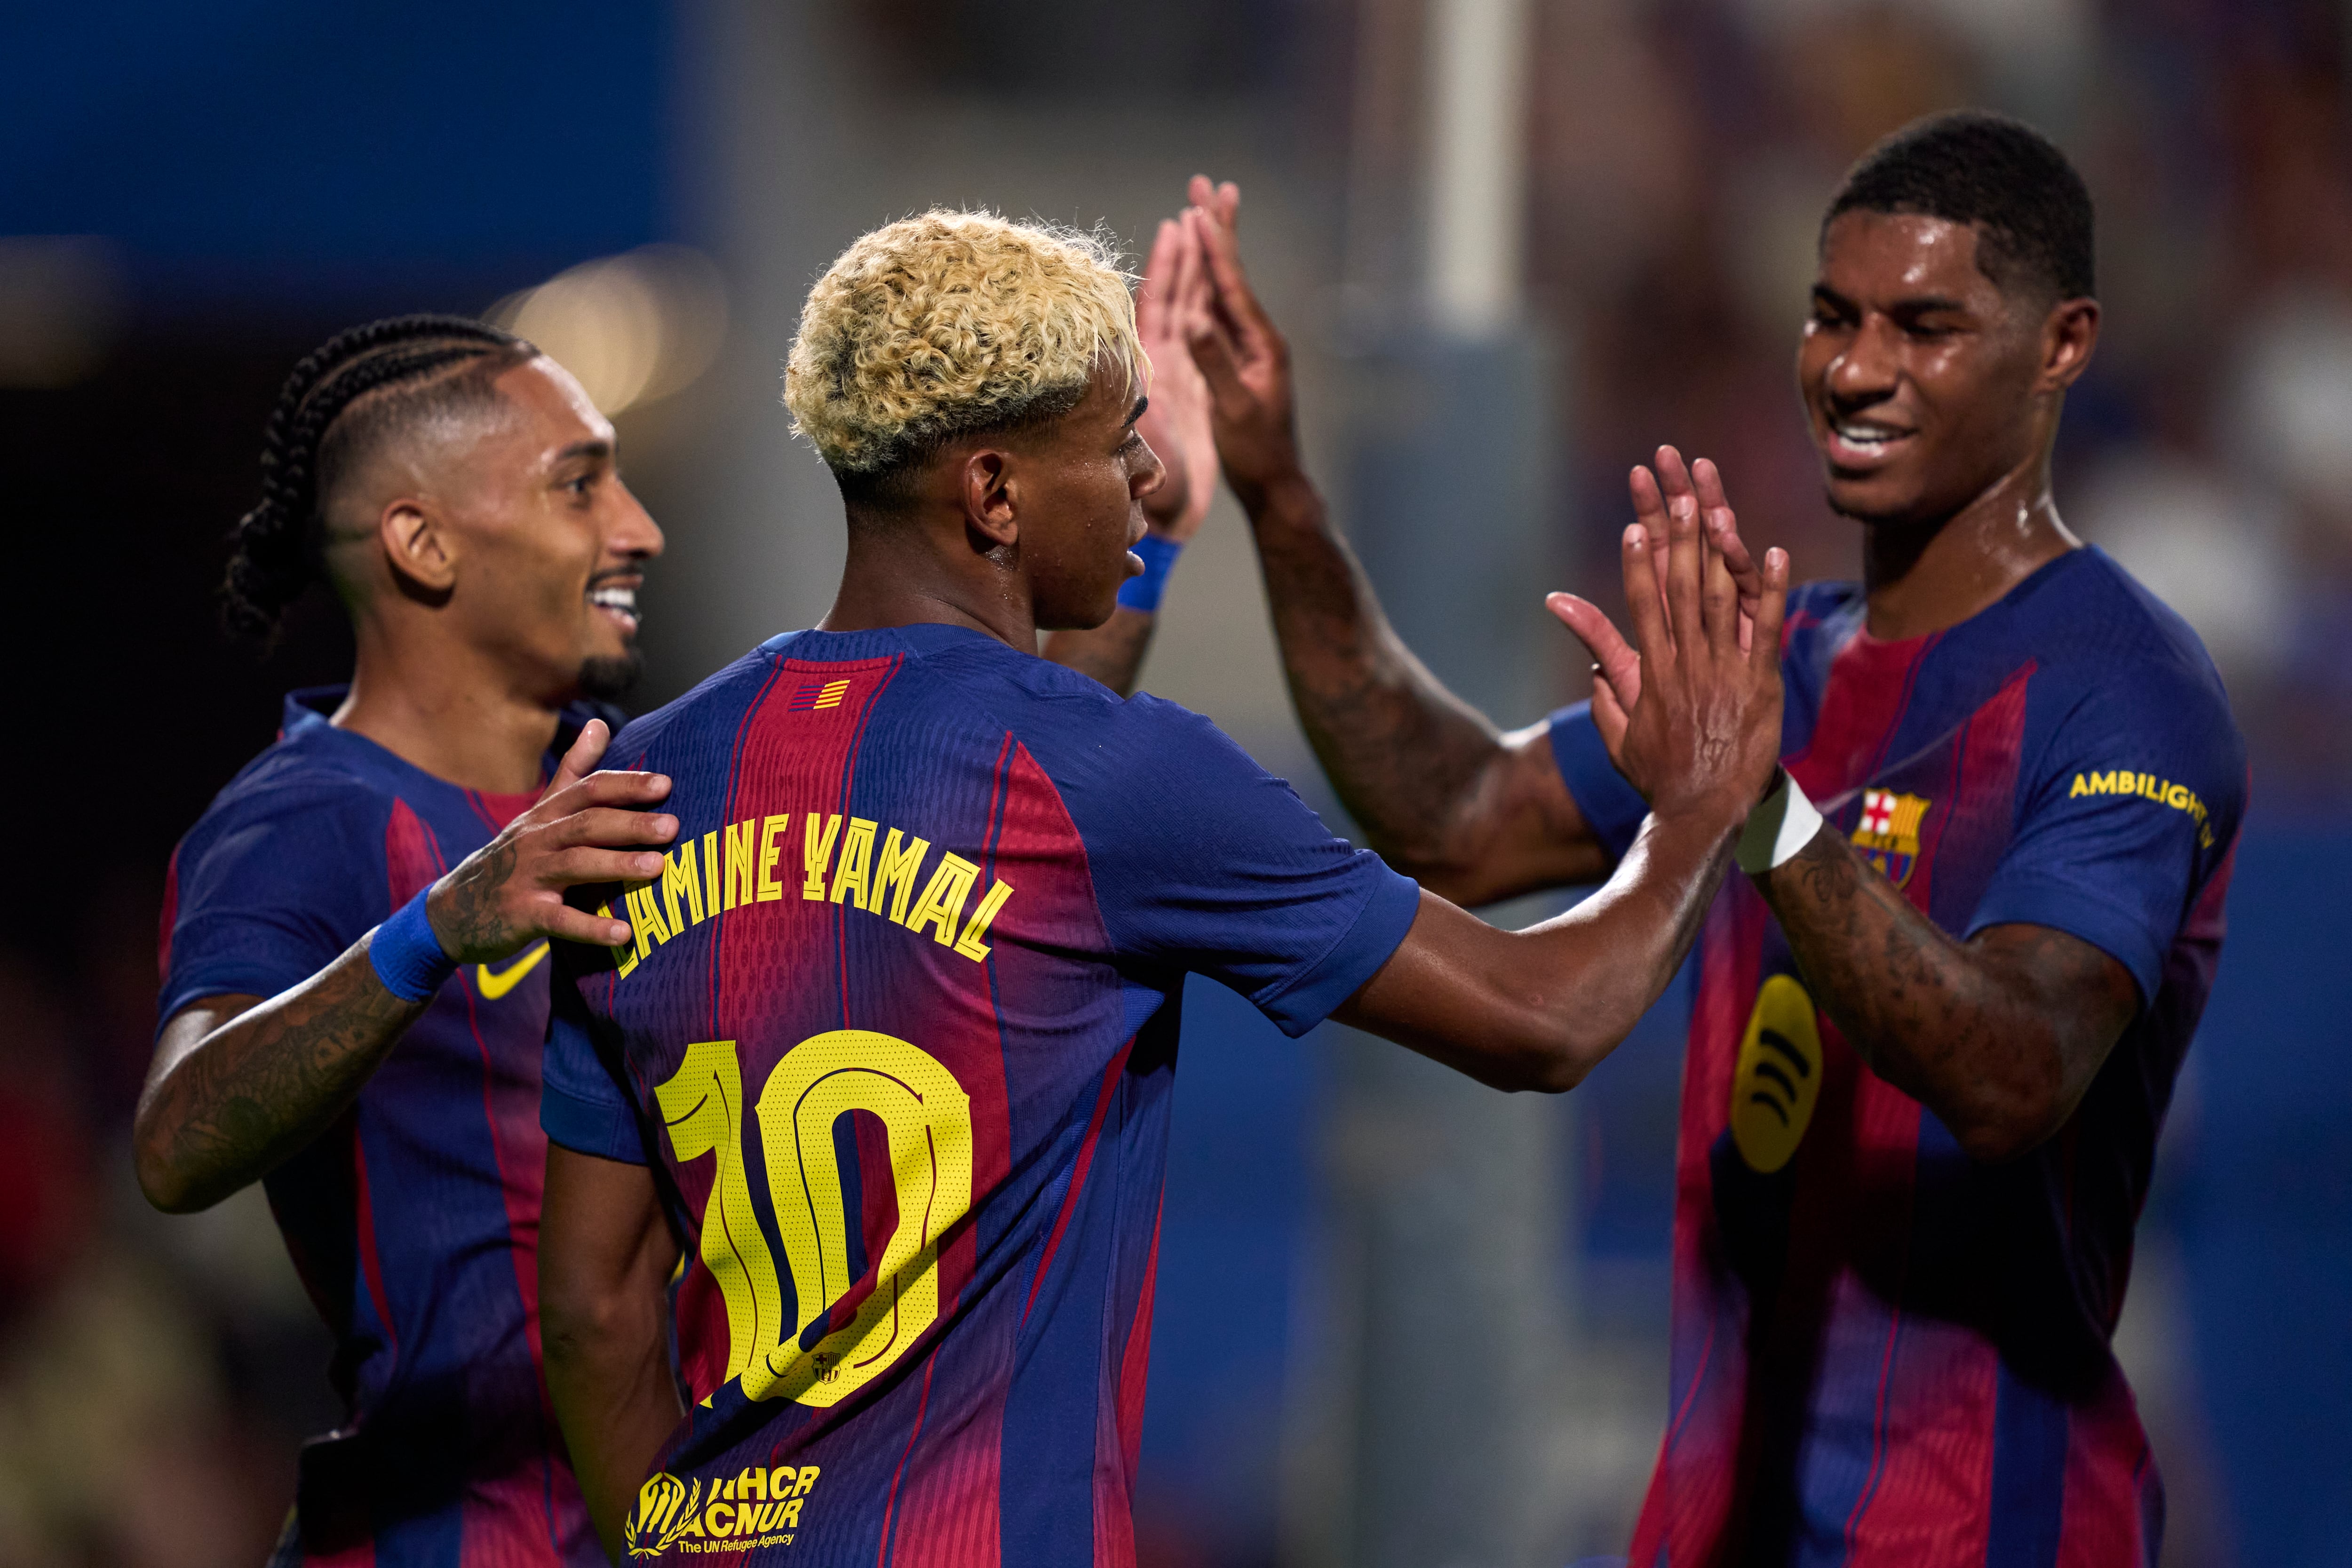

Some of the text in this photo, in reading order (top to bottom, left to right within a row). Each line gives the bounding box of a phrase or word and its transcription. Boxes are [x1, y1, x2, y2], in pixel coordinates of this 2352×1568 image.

[596, 812, 1015, 980] LAMINE YAMAL
[654, 1029, 973, 1408] 10
[678, 1534, 795, 1553] The UN Refugee Agency
[680, 1498, 804, 1538] ACNUR
